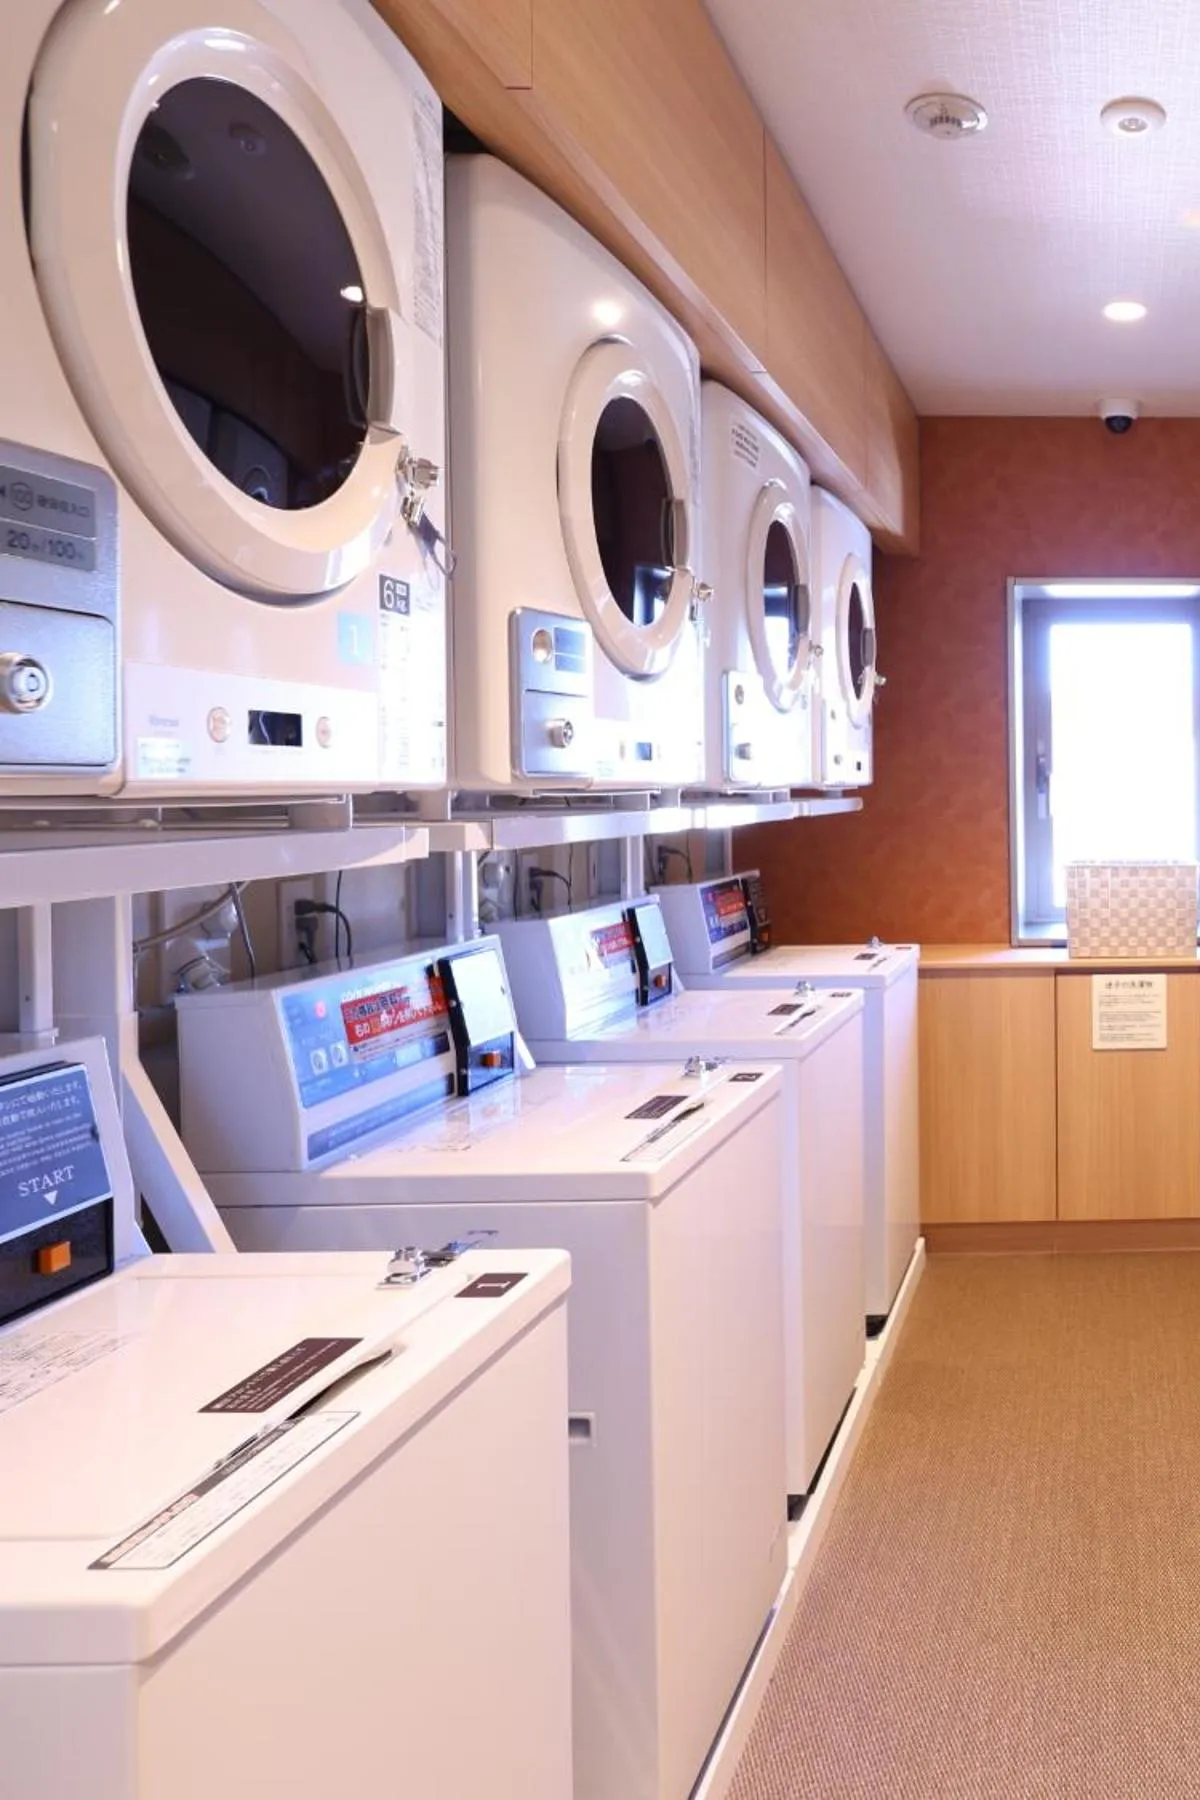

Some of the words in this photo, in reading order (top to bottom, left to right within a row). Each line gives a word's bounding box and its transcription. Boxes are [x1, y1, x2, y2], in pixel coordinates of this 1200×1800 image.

[383, 579, 395, 609] 6
[349, 624, 361, 659] 1
[17, 1164, 76, 1198] START
